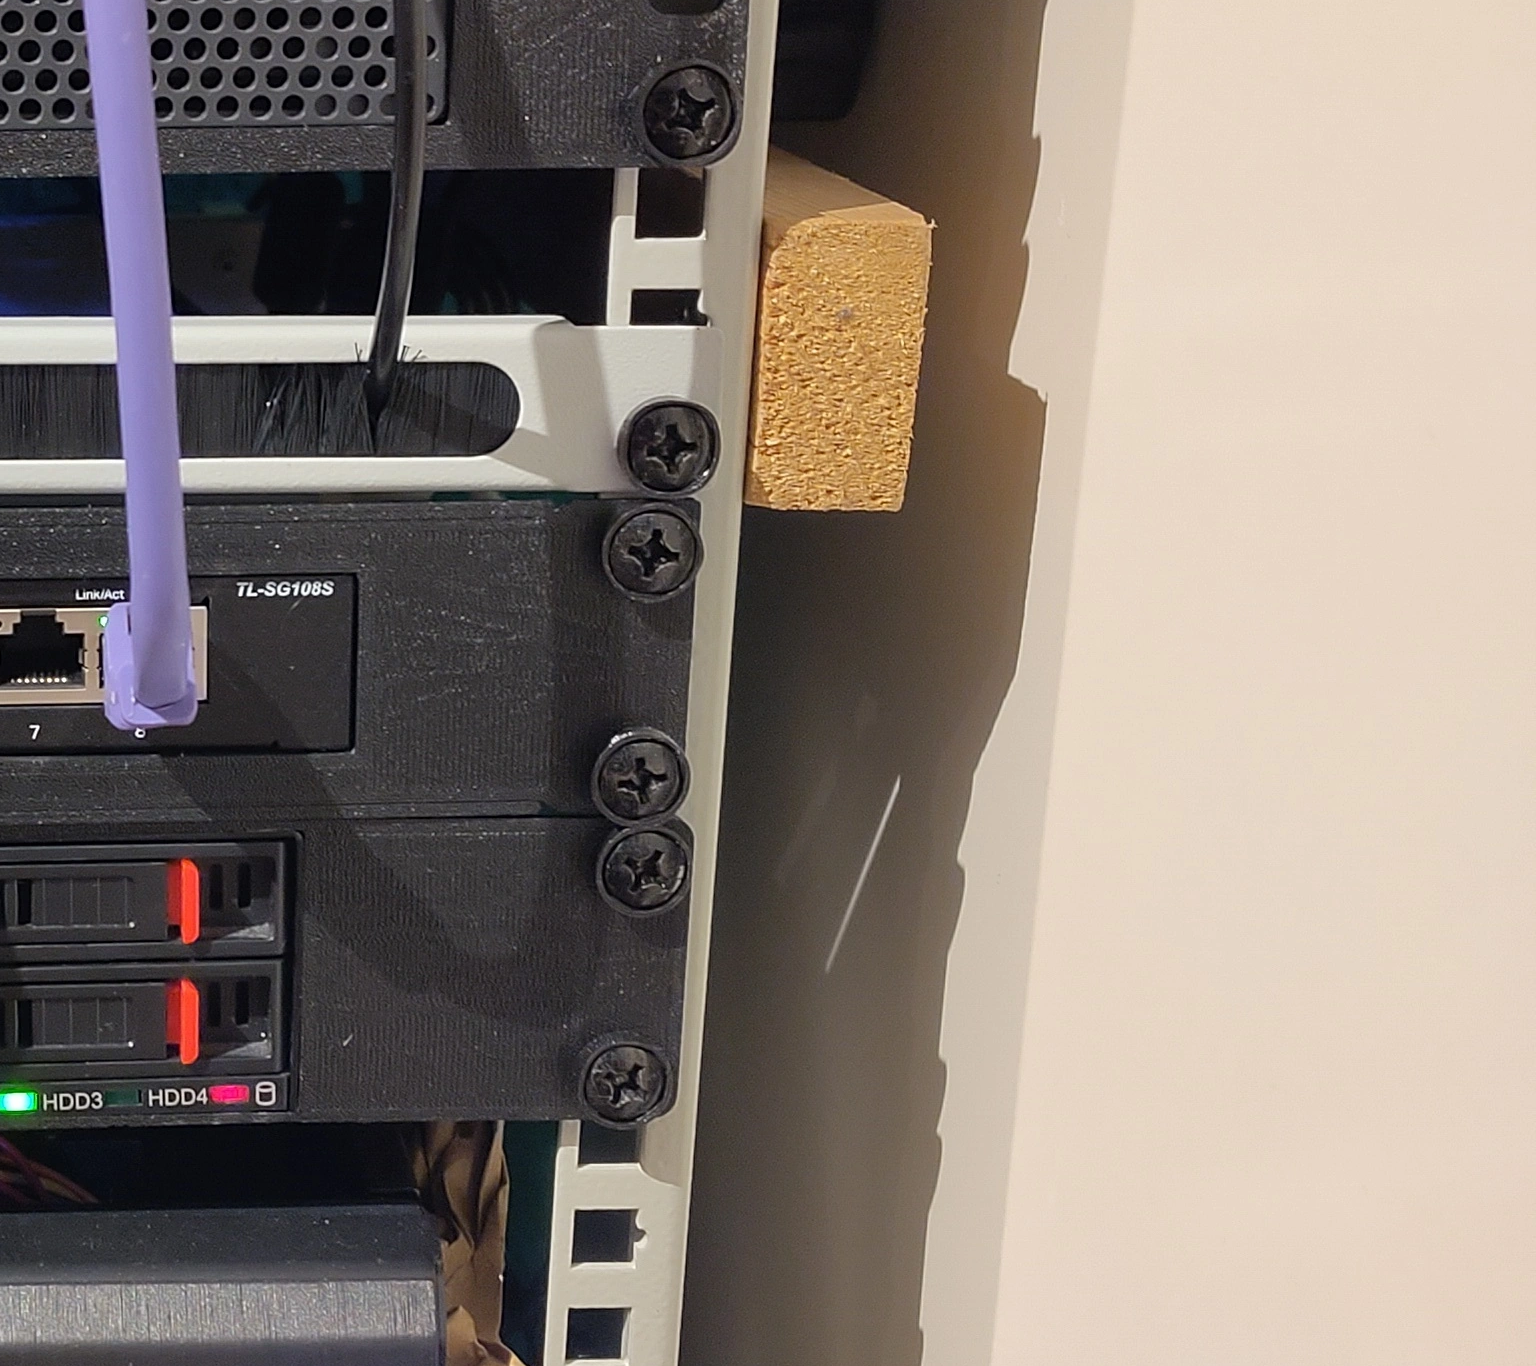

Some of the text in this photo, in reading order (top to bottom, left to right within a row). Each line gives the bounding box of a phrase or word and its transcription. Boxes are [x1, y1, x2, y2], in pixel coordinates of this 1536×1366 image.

[75, 588, 125, 601] Link/Act
[236, 580, 335, 598] TL-SG108S
[28, 725, 41, 740] 7
[42, 1092, 104, 1111] HDD3
[148, 1088, 209, 1107] HDD4
